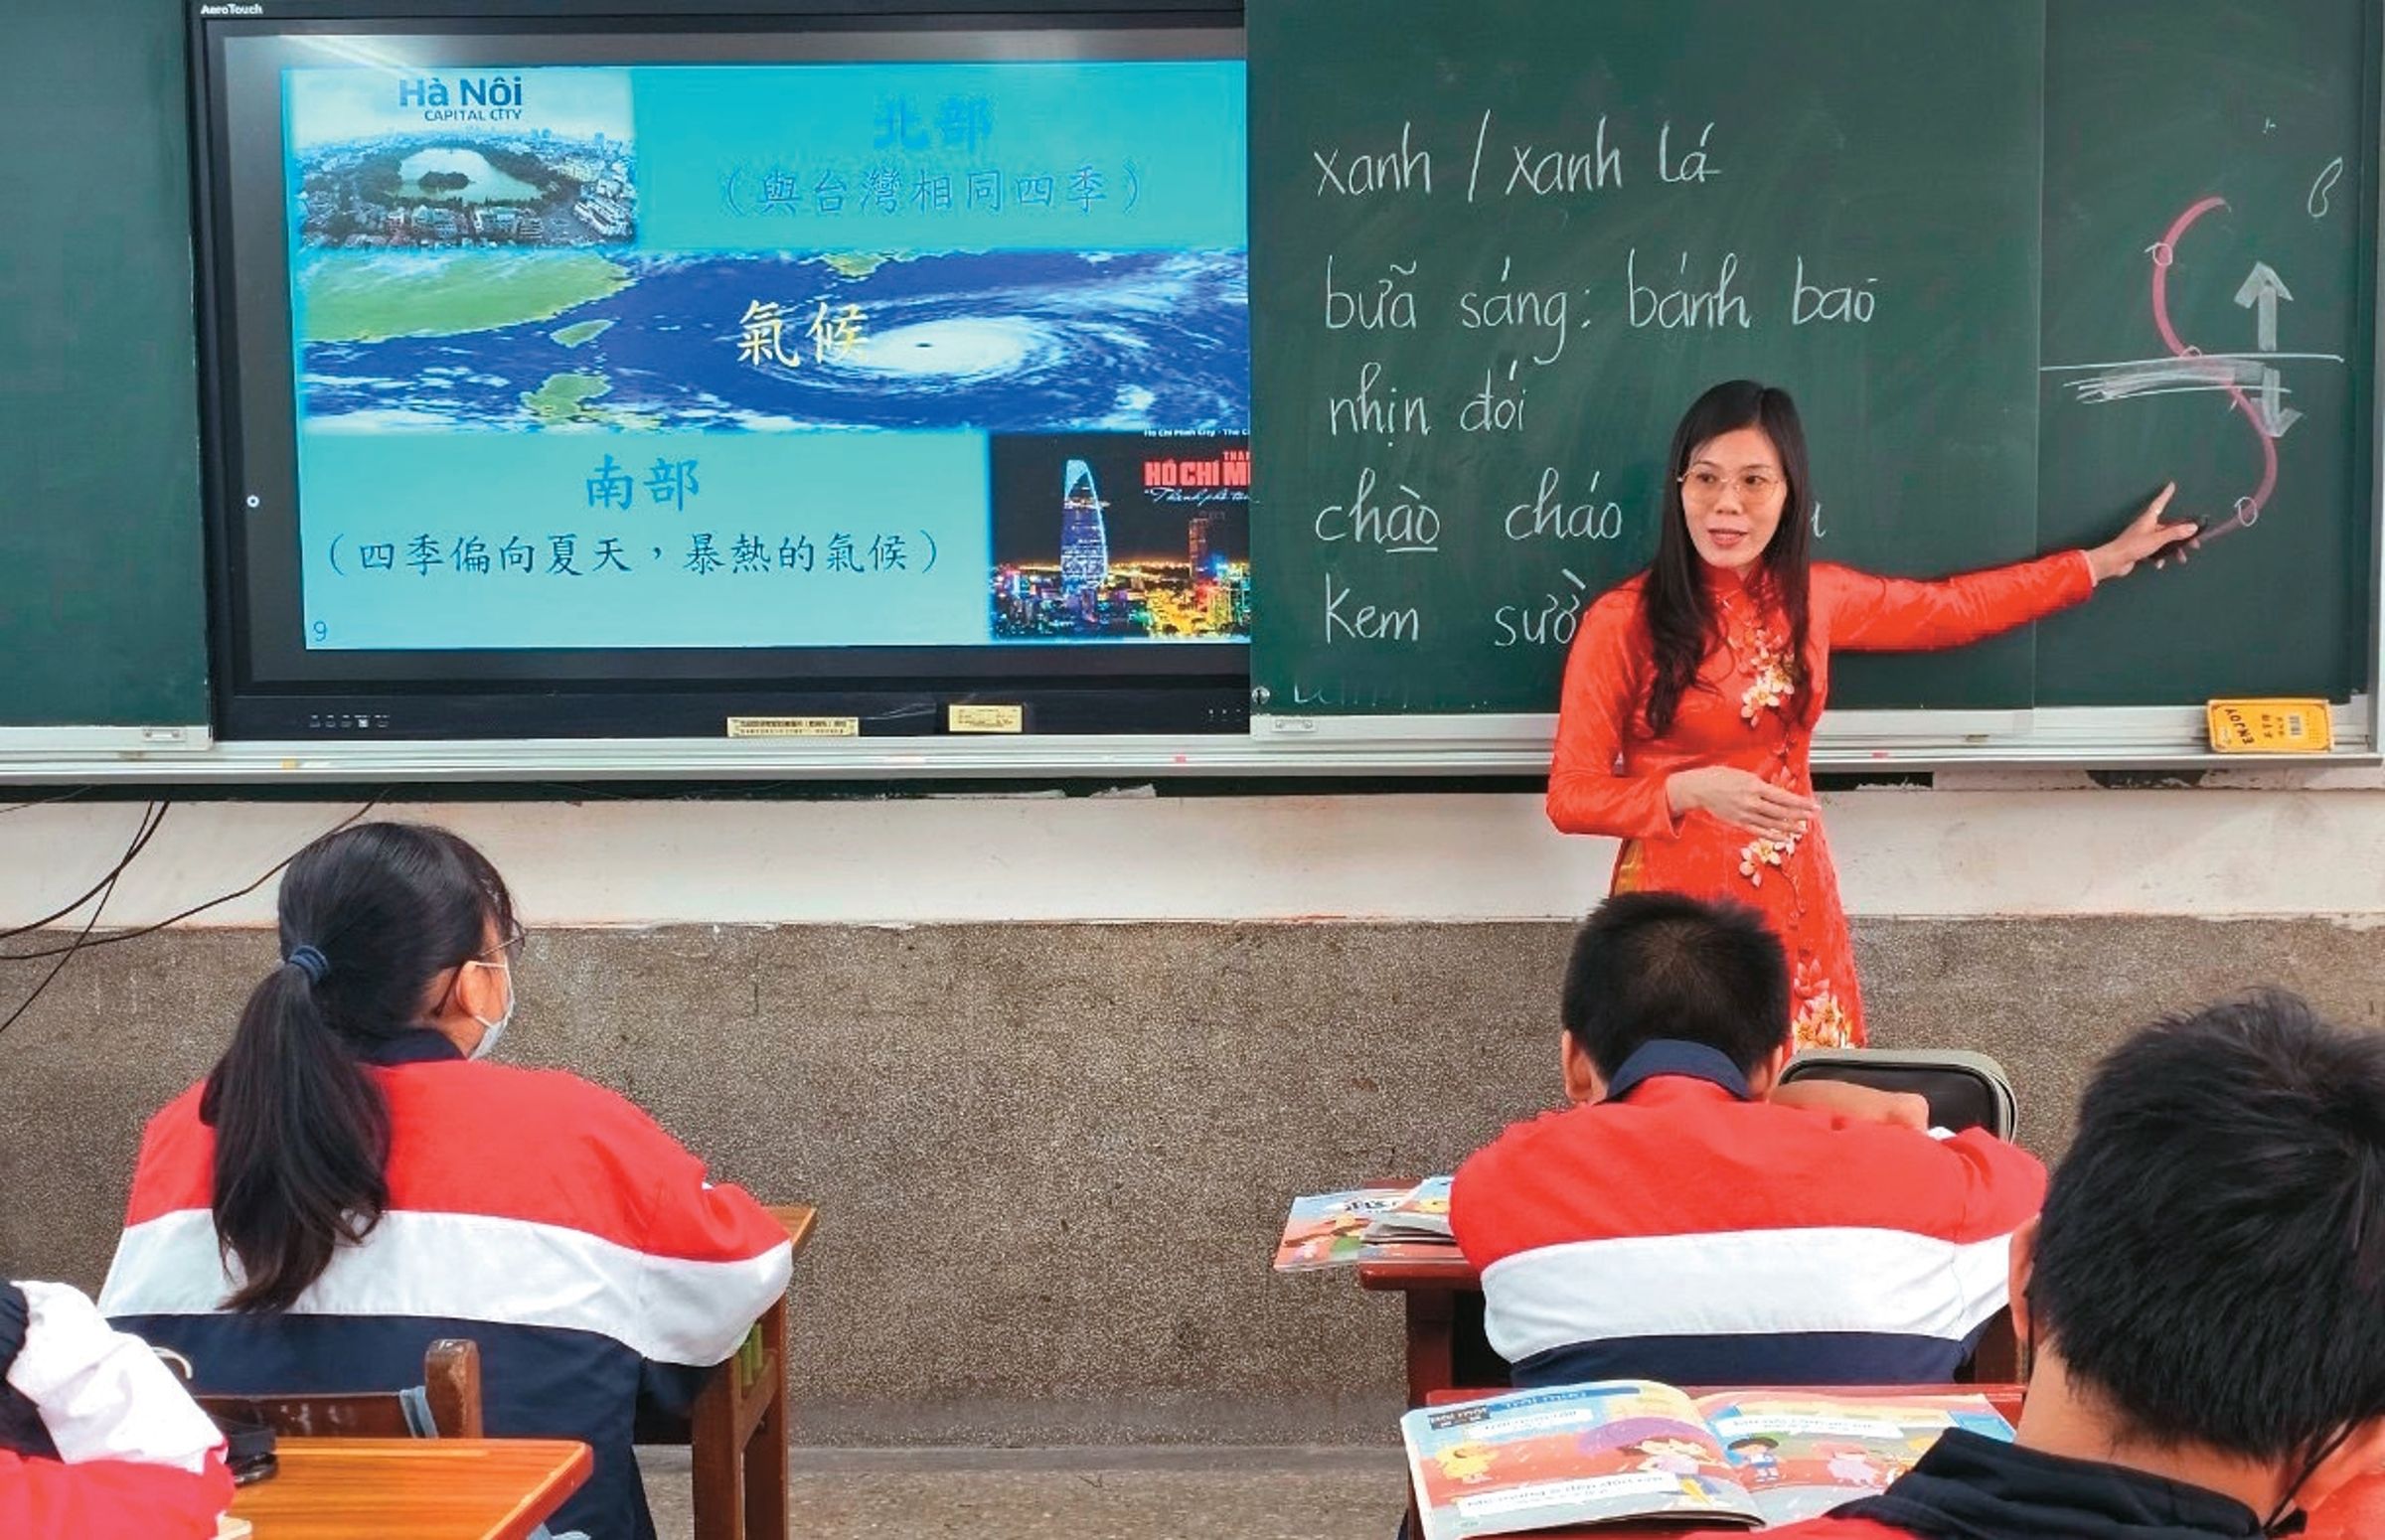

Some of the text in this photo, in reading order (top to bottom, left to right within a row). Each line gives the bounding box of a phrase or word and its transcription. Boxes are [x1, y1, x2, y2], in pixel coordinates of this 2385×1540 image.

[201, 3, 263, 15] AeroTouch
[398, 77, 449, 106] Hà
[424, 108, 523, 121] CAPITAL CITY
[874, 95, 993, 152] 北部
[1314, 120, 1432, 197] xanh
[1505, 114, 1623, 197] xanh
[1627, 247, 1751, 329] bánh
[736, 299, 870, 368] 氣候
[585, 452, 701, 512] 南部
[1315, 466, 1623, 545] chào cháo
[312, 620, 328, 642] 9
[1494, 567, 1586, 647] sườ
